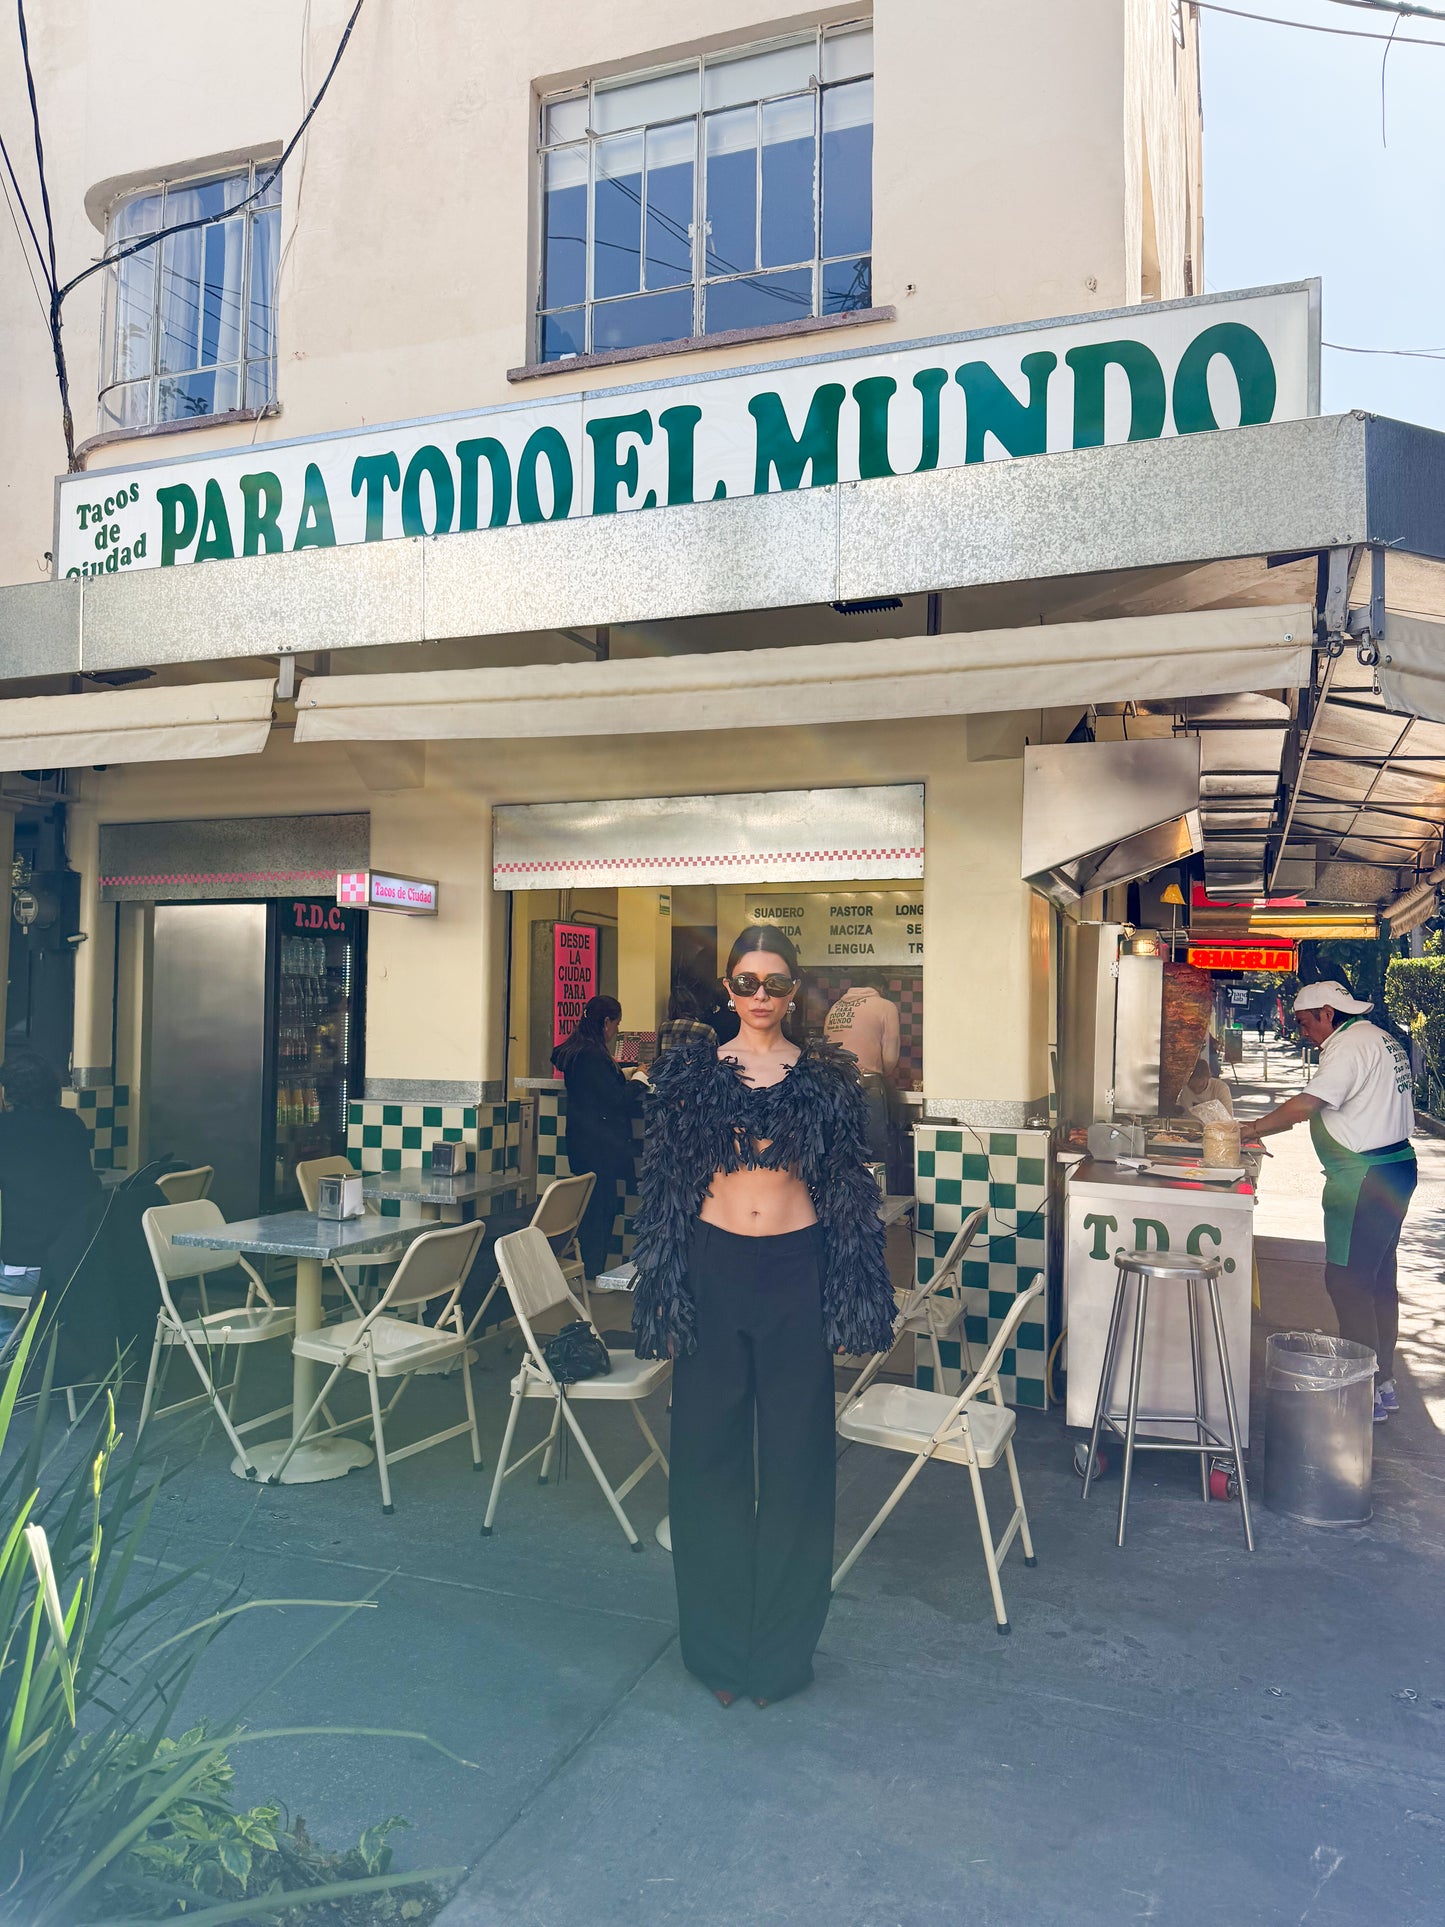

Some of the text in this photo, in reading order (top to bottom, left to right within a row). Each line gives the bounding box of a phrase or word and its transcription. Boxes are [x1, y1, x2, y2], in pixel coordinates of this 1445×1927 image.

[156, 321, 1277, 566] PARA TODO EL MUNDO
[76, 482, 140, 530] Tacos
[94, 523, 121, 550] de
[374, 881, 432, 904] Tacos de Ciudad
[293, 902, 346, 932] T.D.C.
[754, 904, 924, 918] SUADERO PASTOR LONG
[829, 924, 873, 935] MACIZA
[906, 923, 924, 935] SE
[560, 931, 590, 950] DESDE
[827, 942, 924, 955] LENGUA TR
[569, 950, 581, 965] LA
[558, 965, 591, 983] CIUDAD
[563, 983, 586, 1000] PARA
[557, 1001, 580, 1017] TODO
[558, 1019, 580, 1036] MUN
[1083, 1213, 1236, 1273] T.DC.
